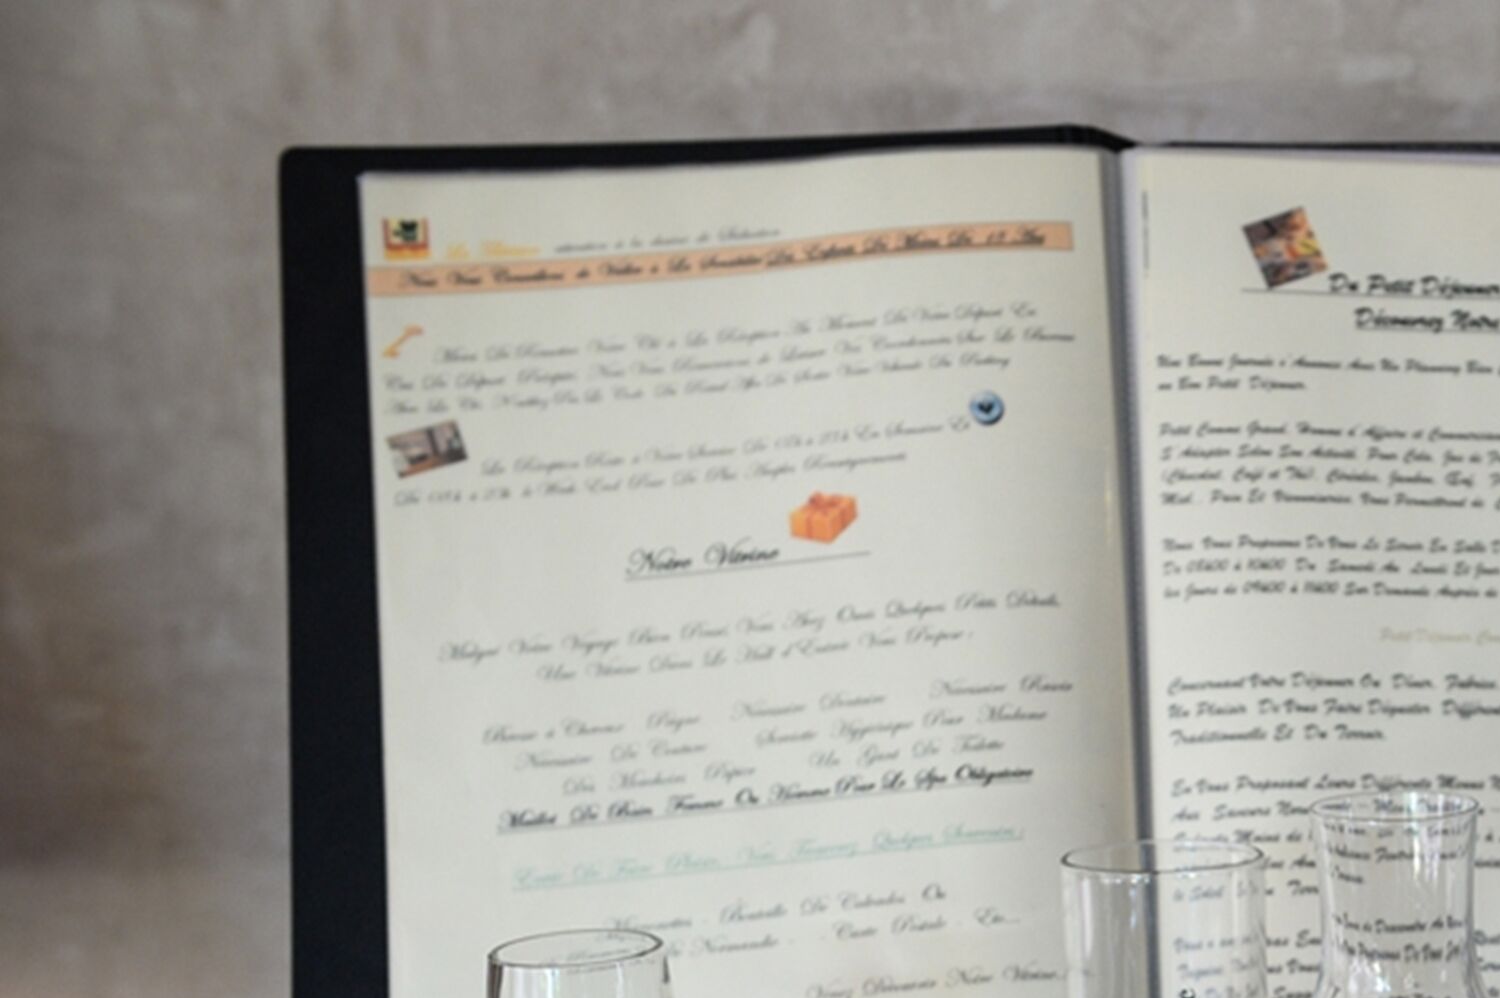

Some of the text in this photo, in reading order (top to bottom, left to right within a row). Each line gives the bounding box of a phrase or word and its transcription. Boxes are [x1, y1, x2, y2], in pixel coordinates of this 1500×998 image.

[1328, 273, 1359, 295] Du
[1367, 274, 1414, 295] Petit
[1420, 275, 1500, 300] Déjeuner
[1353, 306, 1445, 333] Découvrez
[1450, 309, 1500, 330] Notre
[626, 537, 780, 575] Notre Vitrine
